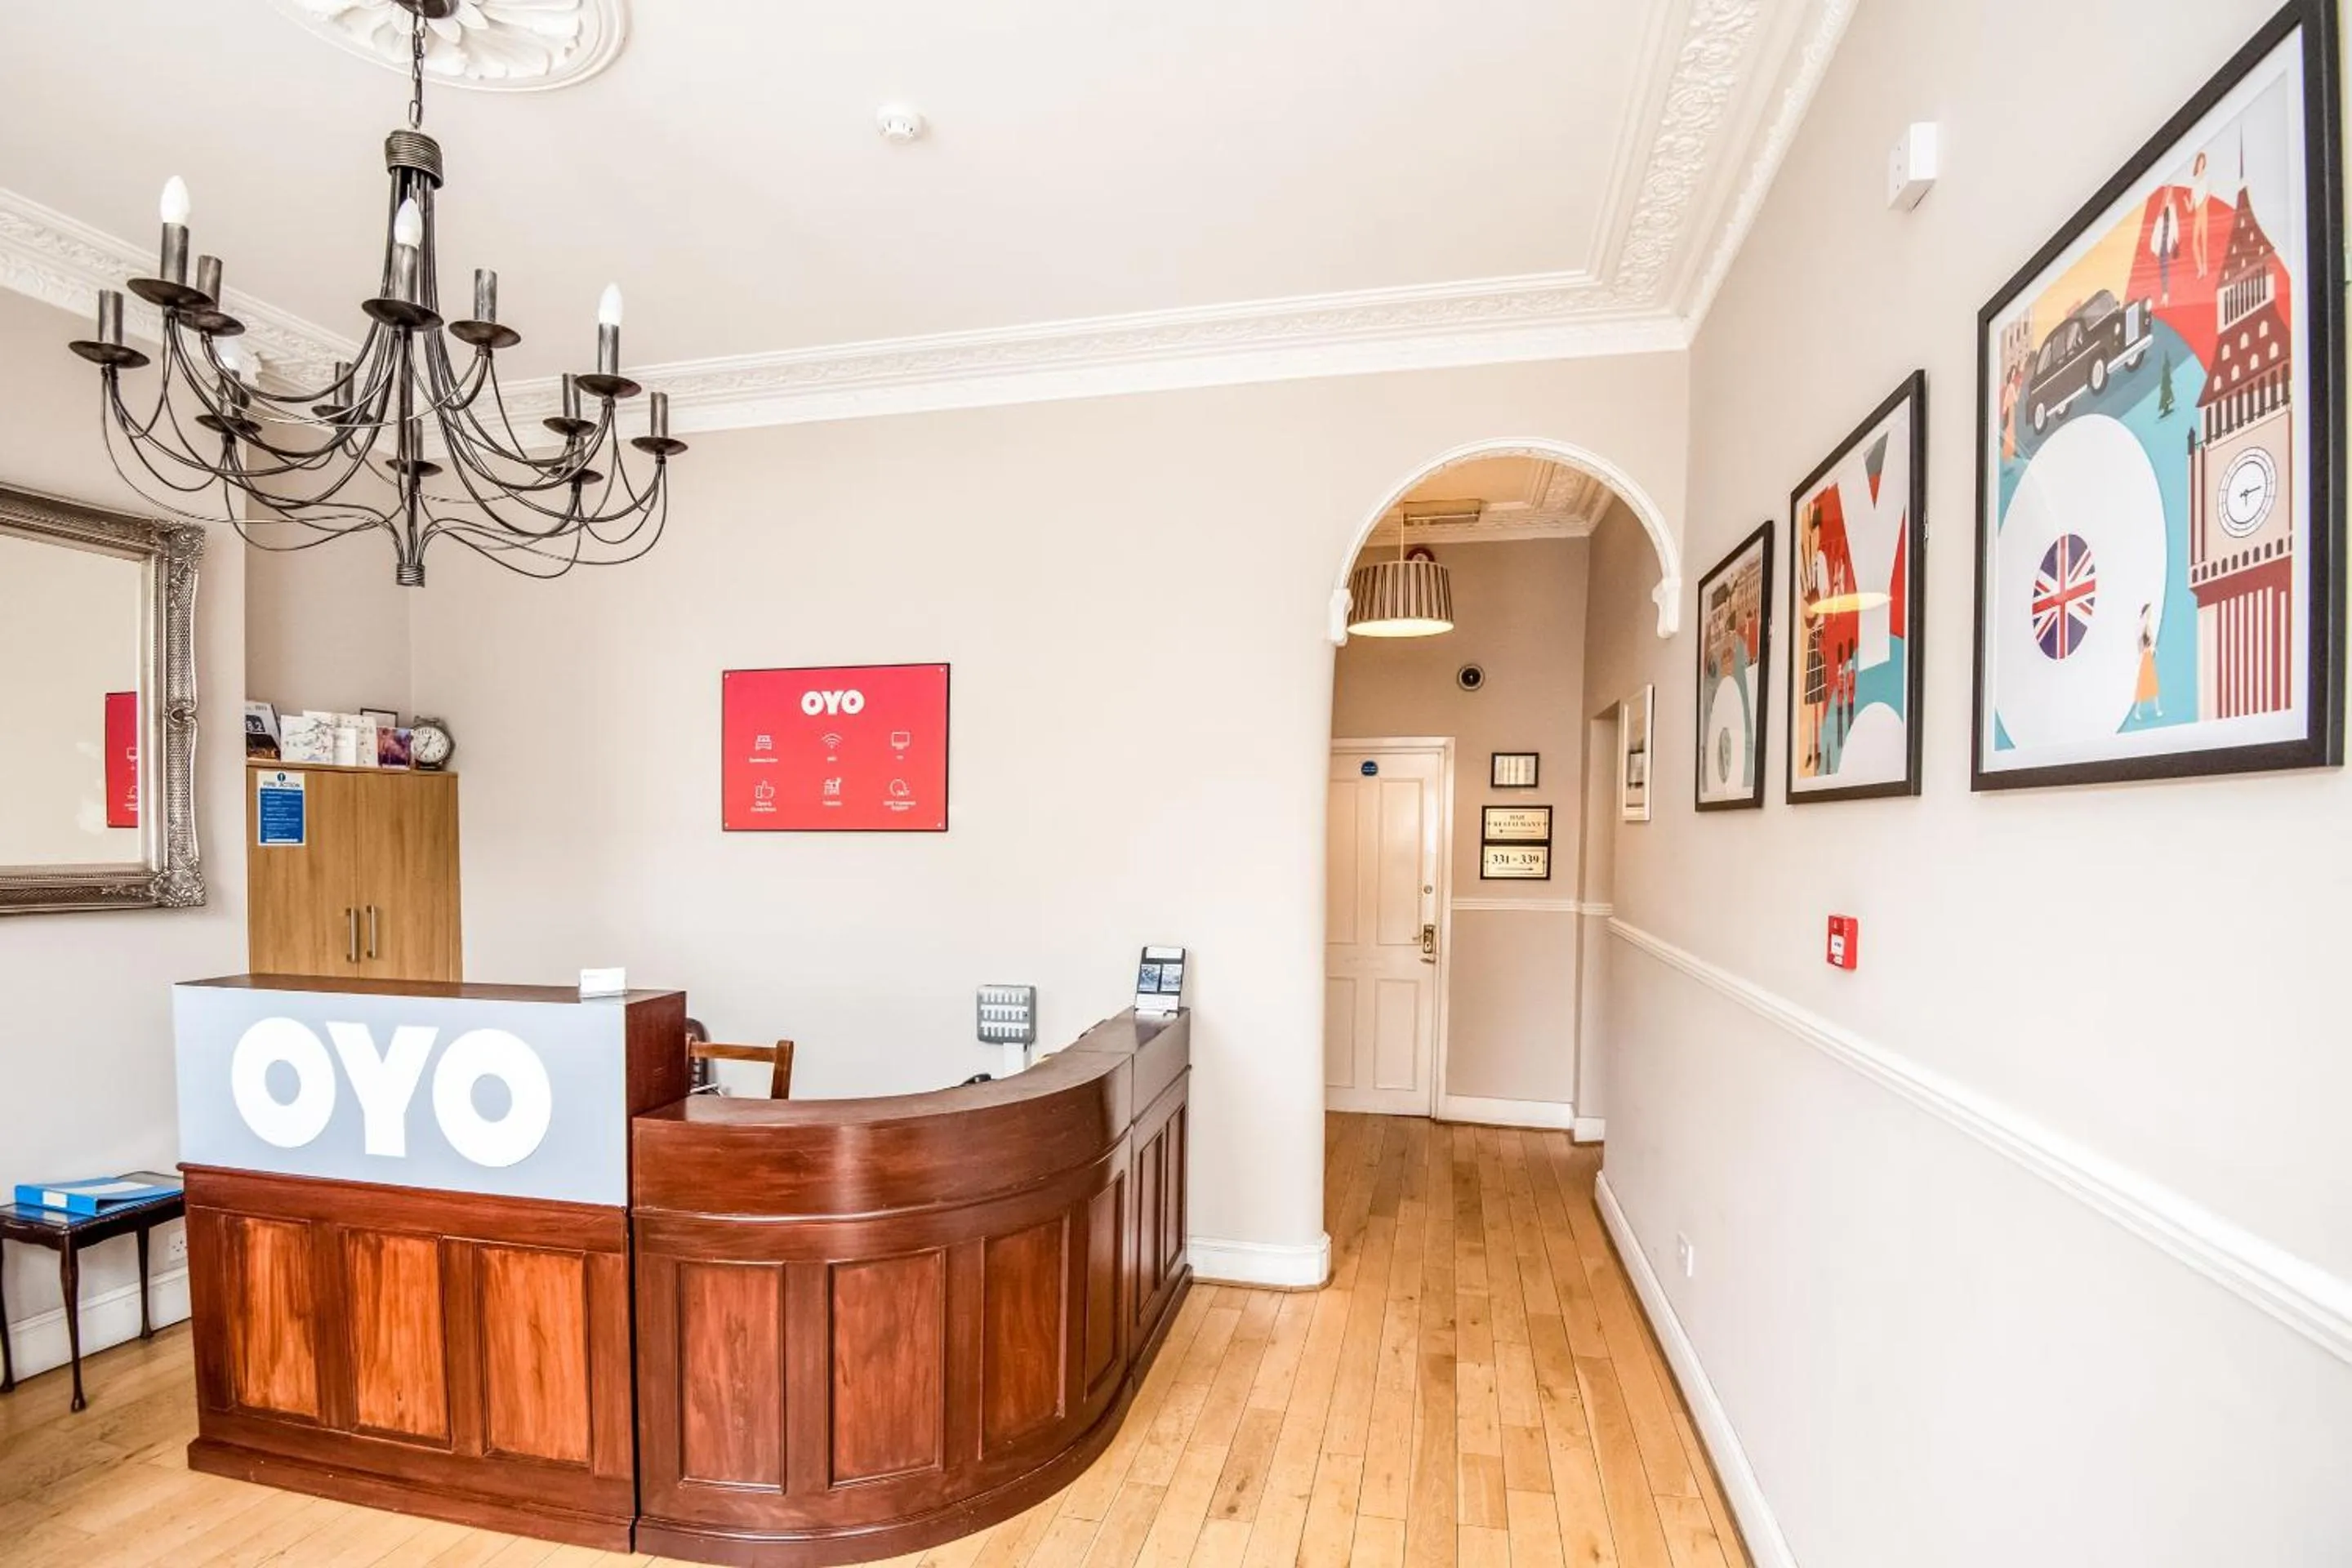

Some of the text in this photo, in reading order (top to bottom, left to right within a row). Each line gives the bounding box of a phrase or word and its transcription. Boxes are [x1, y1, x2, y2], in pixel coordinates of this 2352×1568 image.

[801, 689, 865, 715] OYO
[1492, 854, 1509, 864] 331
[1520, 854, 1539, 864] 339
[231, 1017, 552, 1168] OYO
